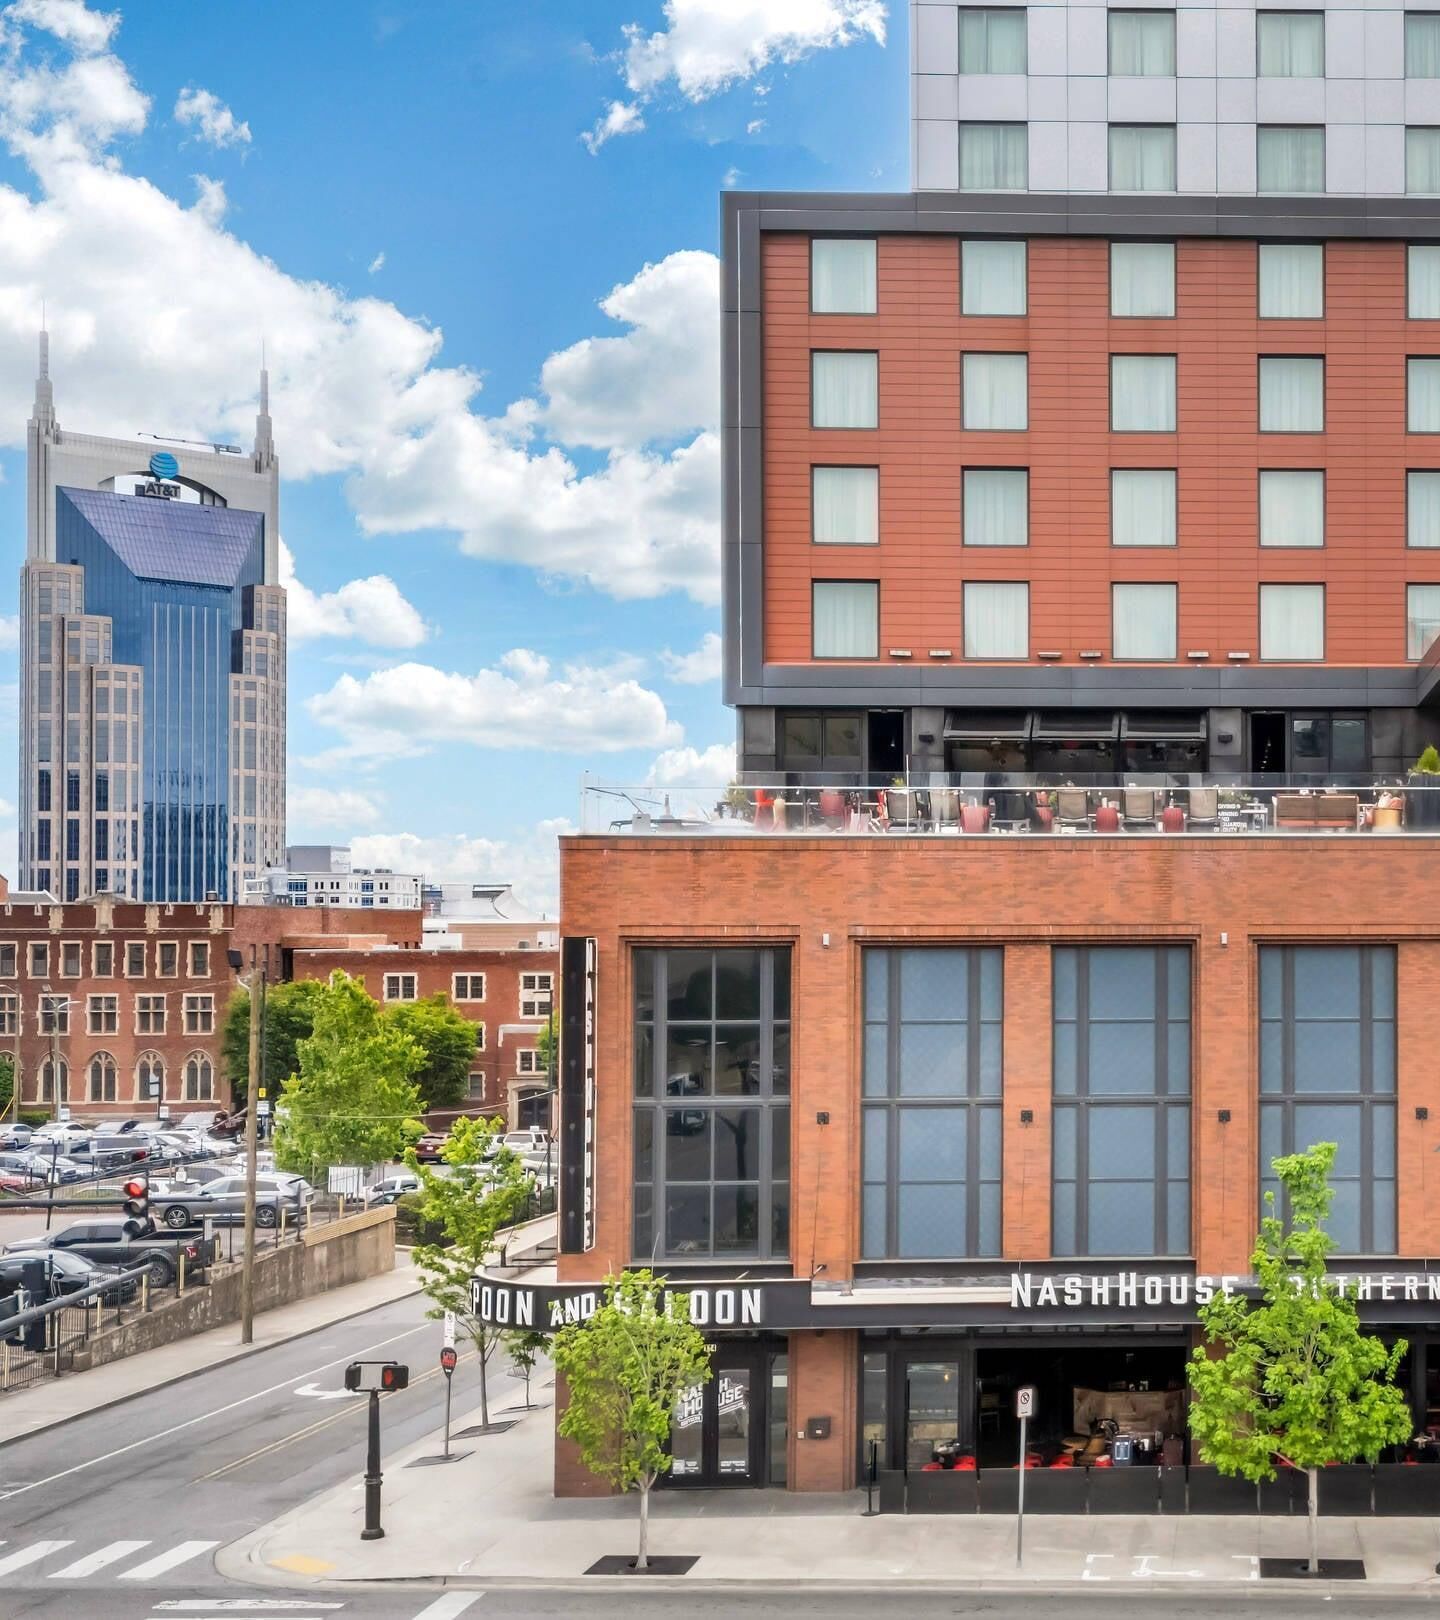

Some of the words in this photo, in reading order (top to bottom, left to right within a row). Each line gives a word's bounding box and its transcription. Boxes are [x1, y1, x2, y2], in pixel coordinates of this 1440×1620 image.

[145, 481, 181, 498] AT&T
[472, 1281, 534, 1326] POON
[550, 1292, 596, 1327] AND
